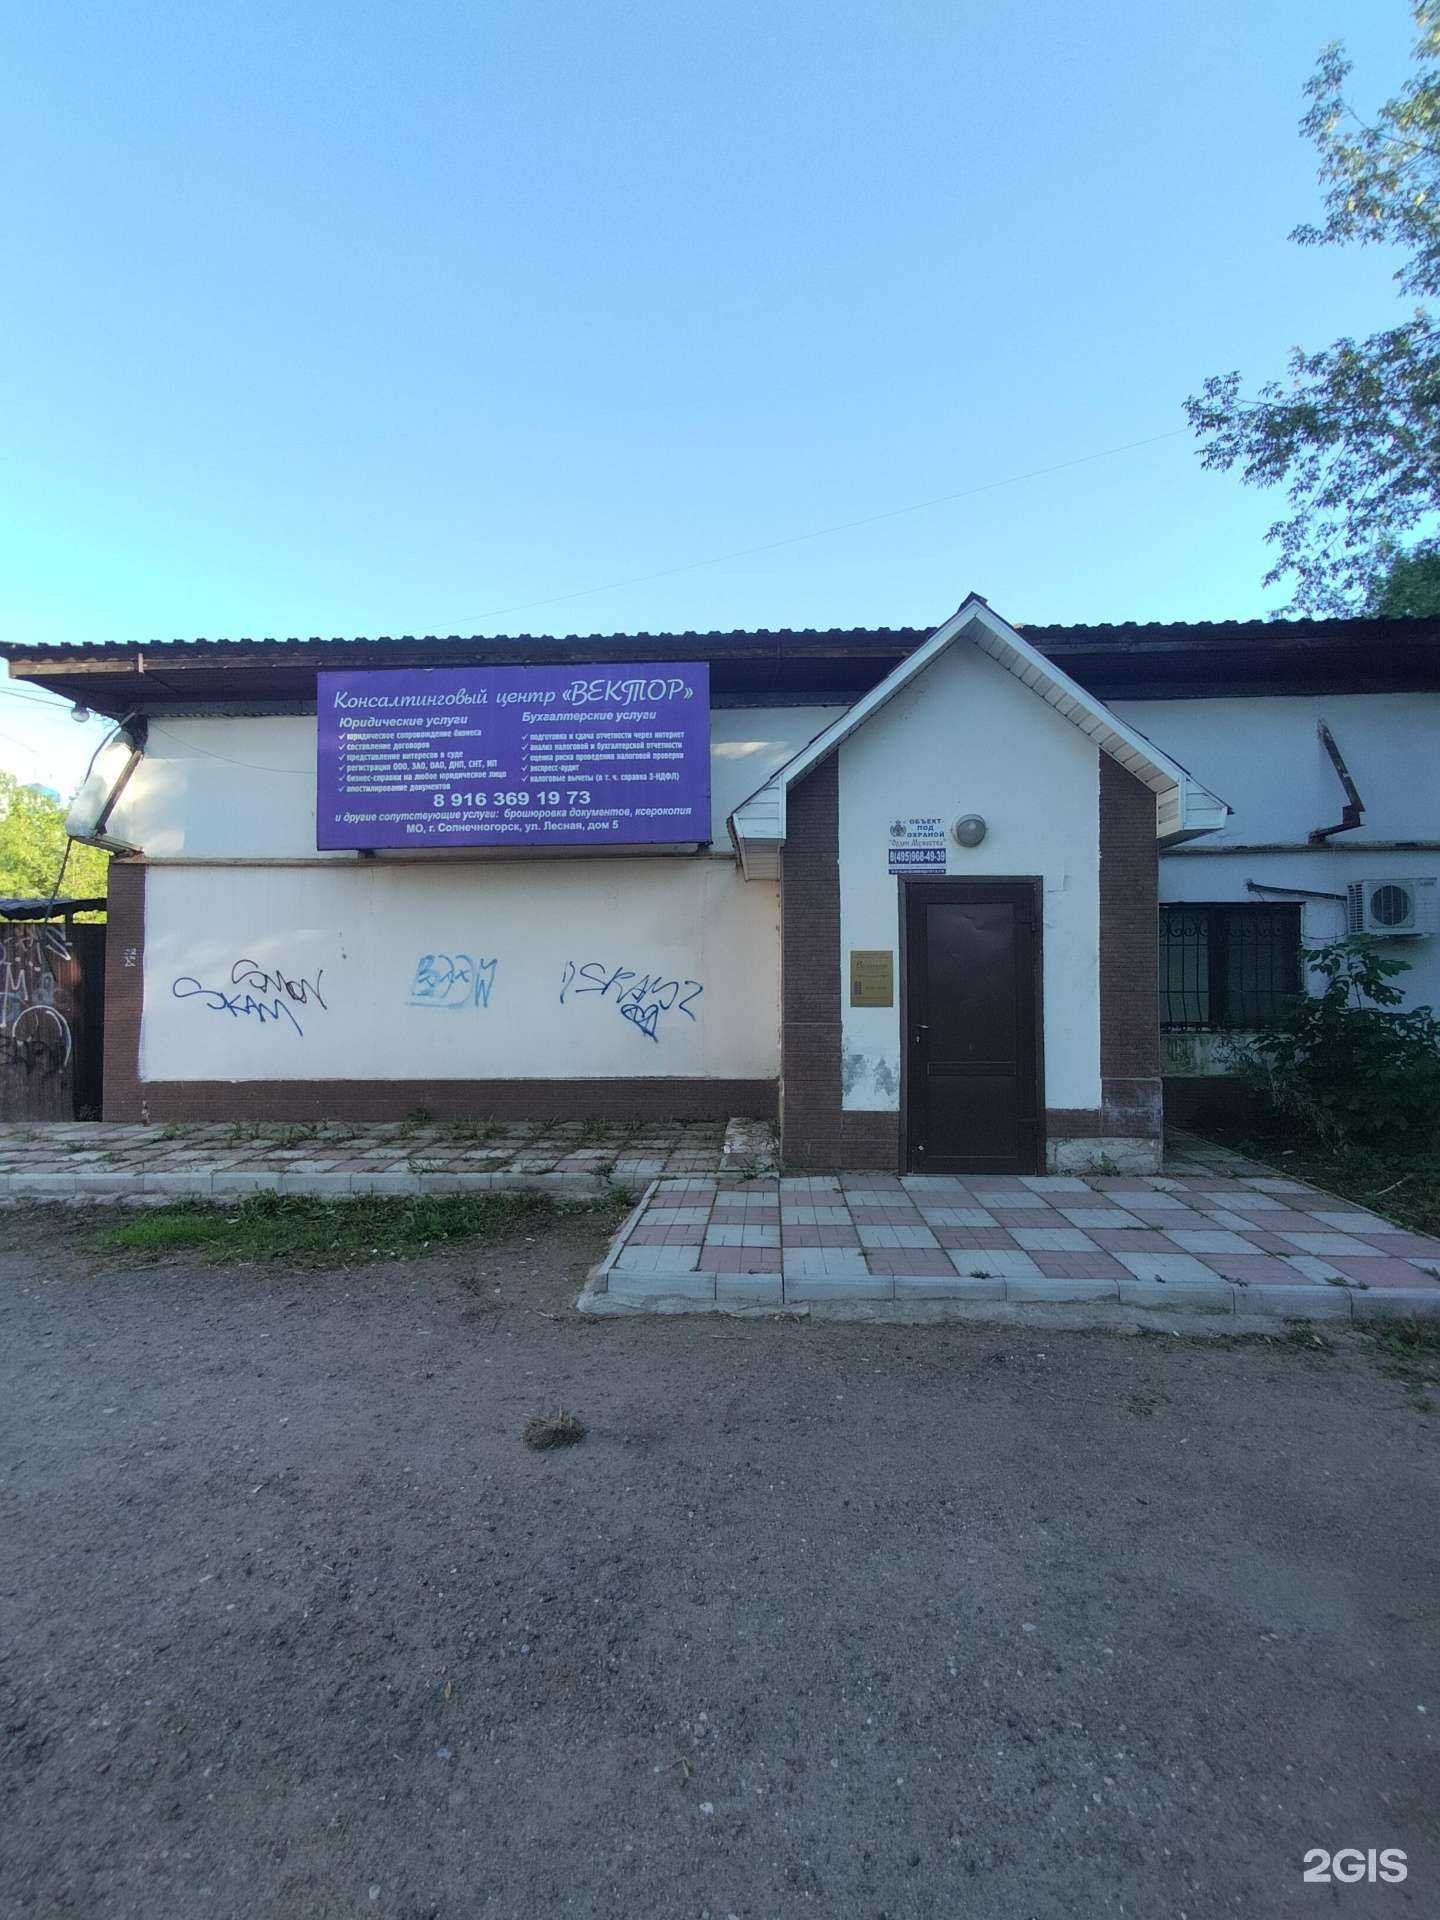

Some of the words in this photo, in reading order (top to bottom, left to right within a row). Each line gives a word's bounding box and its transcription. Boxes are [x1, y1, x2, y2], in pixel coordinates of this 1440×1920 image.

[334, 688, 488, 709] Консалтинговый
[496, 690, 556, 708] центр
[562, 679, 694, 706] «ВЕКТОР»
[339, 717, 424, 729] Юридические
[426, 715, 468, 729] услуги
[521, 711, 614, 724] Бухгалтерские
[615, 710, 657, 723] услуги
[347, 732, 395, 741] юридическое
[396, 730, 452, 740] сопровождение
[453, 729, 482, 738] бизнеса
[530, 732, 567, 741] подготовка
[575, 733, 595, 741] сдача
[596, 732, 632, 740] отчетности
[633, 732, 653, 740] через
[654, 731, 685, 740] интернет
[347, 742, 391, 751] составление
[393, 741, 430, 751] договоров
[530, 743, 553, 751] анализ
[554, 742, 589, 750] налоговой
[596, 741, 645, 751] бухгалтерской
[646, 741, 683, 749] отчетности
[347, 752, 401, 762] представление
[402, 751, 438, 761] интересов
[446, 751, 464, 760] суде
[530, 754, 553, 763] оценка
[555, 754, 574, 762] риска
[616, 752, 651, 760] налоговой
[652, 752, 684, 761] проверки
[393, 761, 410, 771] ООО,
[411, 761, 428, 771] ЗАО,
[430, 760, 447, 770] ОАО,
[448, 760, 467, 770] ДНП,
[468, 760, 485, 769] СНТ,
[487, 759, 498, 768] ИП
[530, 763, 580, 773] экспресс-аудит
[414, 772, 438, 781] любое
[439, 771, 487, 782] юридическое
[489, 770, 507, 779] лицо
[530, 774, 566, 783] налоговые
[567, 774, 594, 782] вычеты
[605, 774, 611, 782] т.
[409, 782, 451, 793] документов
[433, 793, 445, 807] 8
[450, 792, 487, 807] 916
[493, 791, 530, 806] 369
[536, 791, 560, 805] 19
[566, 790, 591, 805] 73
[335, 814, 341, 822] и
[343, 811, 377, 825] другие
[378, 810, 461, 823] сопутствующие
[462, 808, 499, 821] услуги:
[504, 807, 567, 820] брошюровка
[568, 807, 633, 819] документов,
[634, 806, 692, 818] ксерокопия
[406, 823, 426, 834] МО,
[428, 824, 436, 833] г.
[438, 822, 522, 834] Солнечногорск,
[525, 823, 541, 834] ул.
[543, 821, 585, 832] Лесная,
[586, 820, 610, 831] дом
[612, 819, 619, 829] 5
